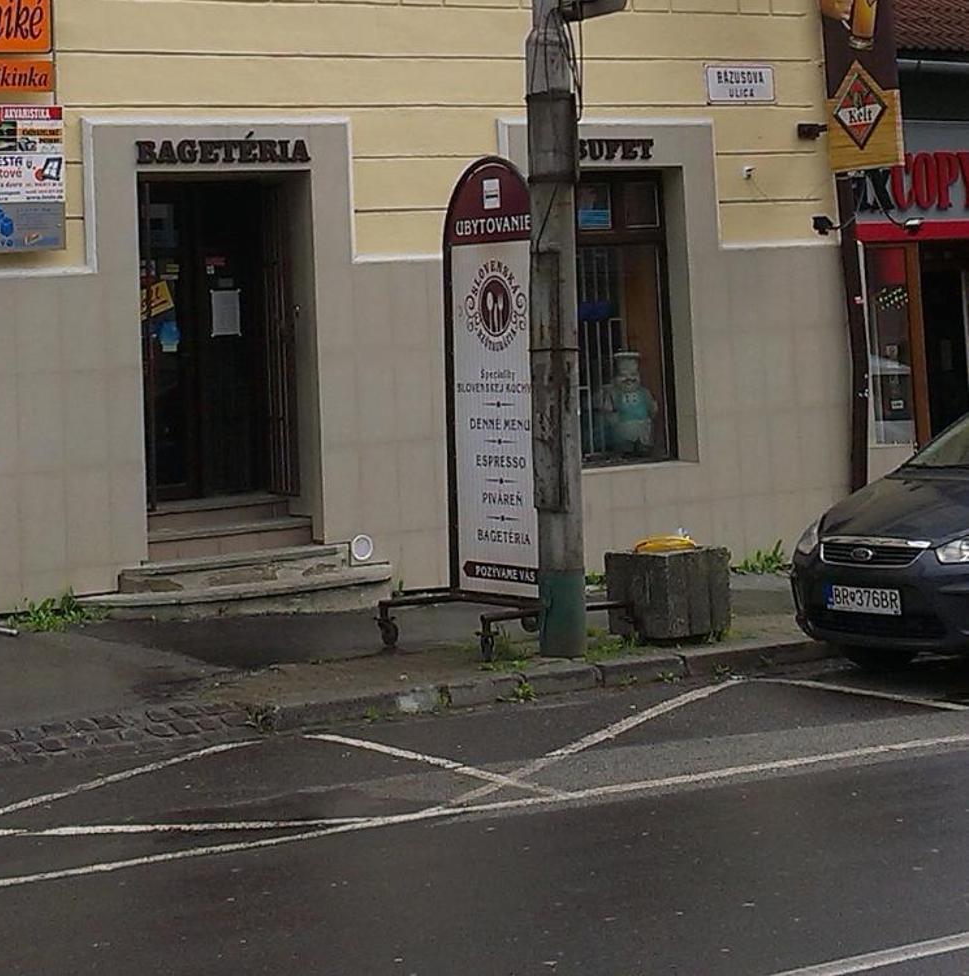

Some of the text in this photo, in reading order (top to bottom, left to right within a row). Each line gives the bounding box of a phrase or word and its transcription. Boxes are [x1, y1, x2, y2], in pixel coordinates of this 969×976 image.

[729, 88, 754, 98] ULICA
[848, 108, 872, 123] Kelt
[136, 130, 311, 164] BAGETÉRIA
[455, 214, 530, 236] UBYTOVANIE
[476, 454, 526, 469] ESPRESSO
[477, 527, 531, 545] BAGETÉRIA
